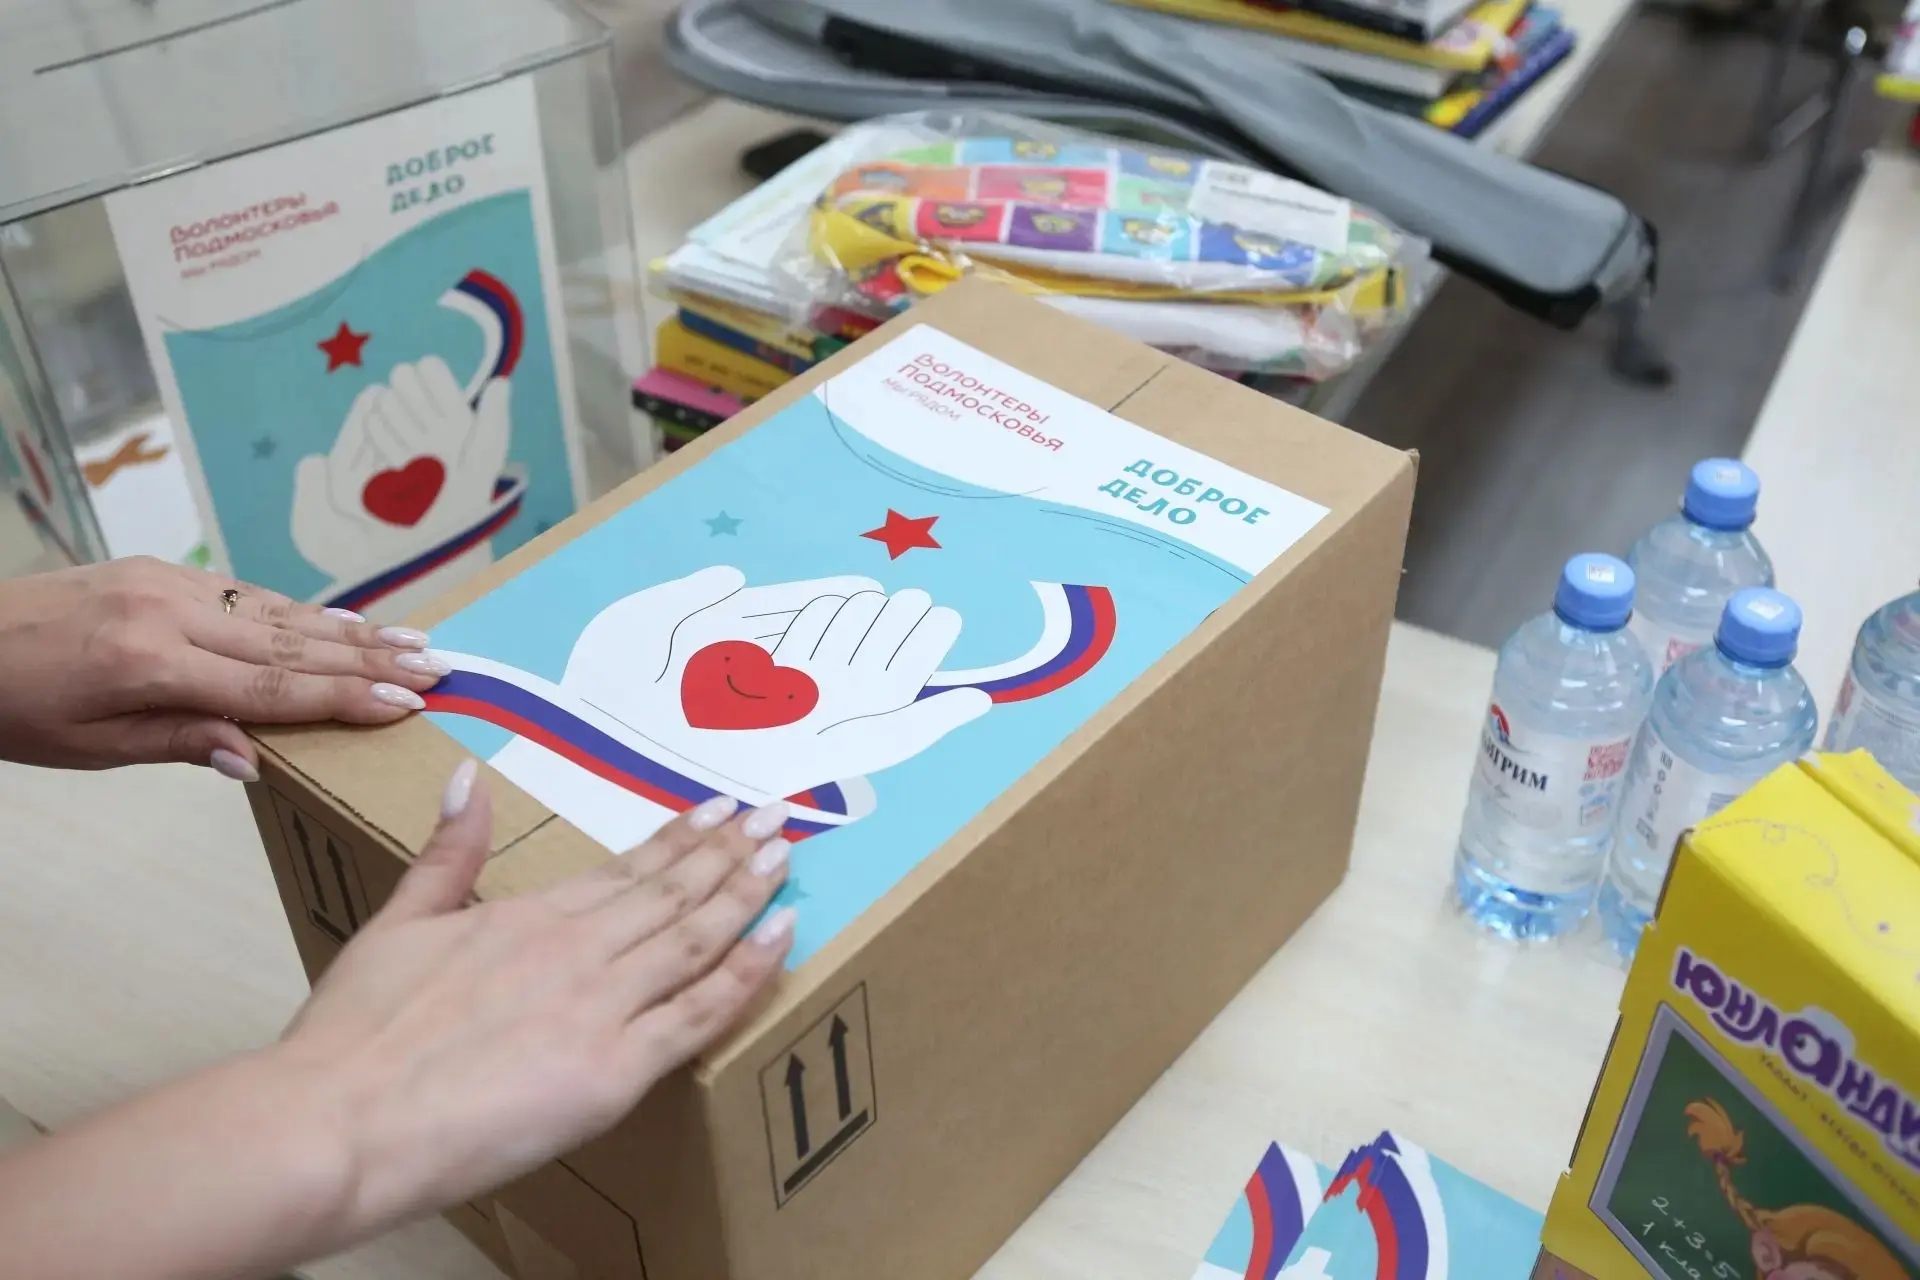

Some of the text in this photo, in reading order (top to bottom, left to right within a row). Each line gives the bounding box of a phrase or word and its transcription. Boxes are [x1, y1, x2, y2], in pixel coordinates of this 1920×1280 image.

[386, 133, 495, 187] ДОБРОЕ
[390, 173, 465, 213] ДЕЛО
[897, 363, 1064, 451] ПОДМОСКОВЬЯ
[906, 389, 962, 421] РЯДОМ
[914, 353, 1050, 424] ВОЛОНТЕРЫ
[1098, 479, 1197, 525] ДЕЛО
[1123, 459, 1271, 525] ДОБРОЕ
